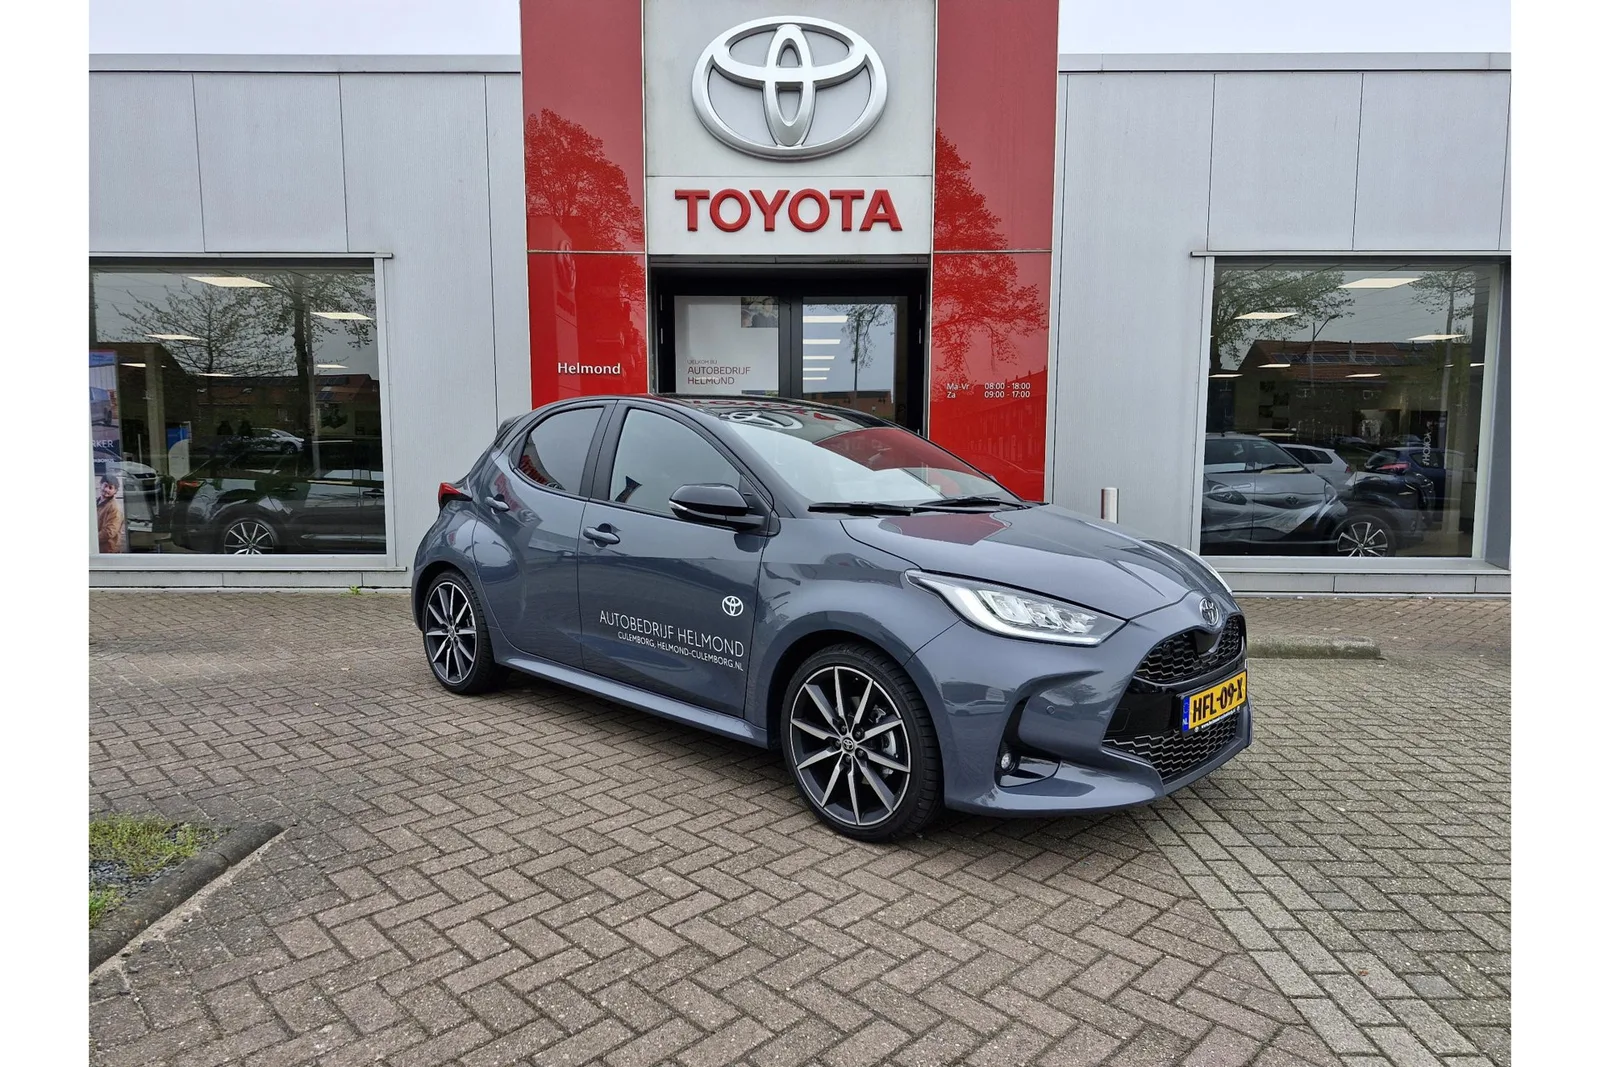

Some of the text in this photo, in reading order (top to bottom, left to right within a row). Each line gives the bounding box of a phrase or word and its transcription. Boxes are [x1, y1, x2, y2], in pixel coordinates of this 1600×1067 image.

[675, 188, 903, 232] TOYOTA
[557, 362, 621, 375] Helmond
[687, 366, 751, 375] AUTOBEDRIJF
[687, 376, 735, 385] HELMOND
[984, 382, 1005, 390] 08:00
[1012, 382, 1031, 390] 18:00
[946, 391, 956, 399] Za
[984, 390, 1005, 398] 09:00
[1012, 390, 1031, 398] 17:00
[600, 610, 745, 658] AUTOBEDRIJF HELMOND
[617, 631, 744, 672] CULEMBORG, HELMOND-CULEMBORG.NL
[1192, 677, 1244, 724] HFL-09-X
